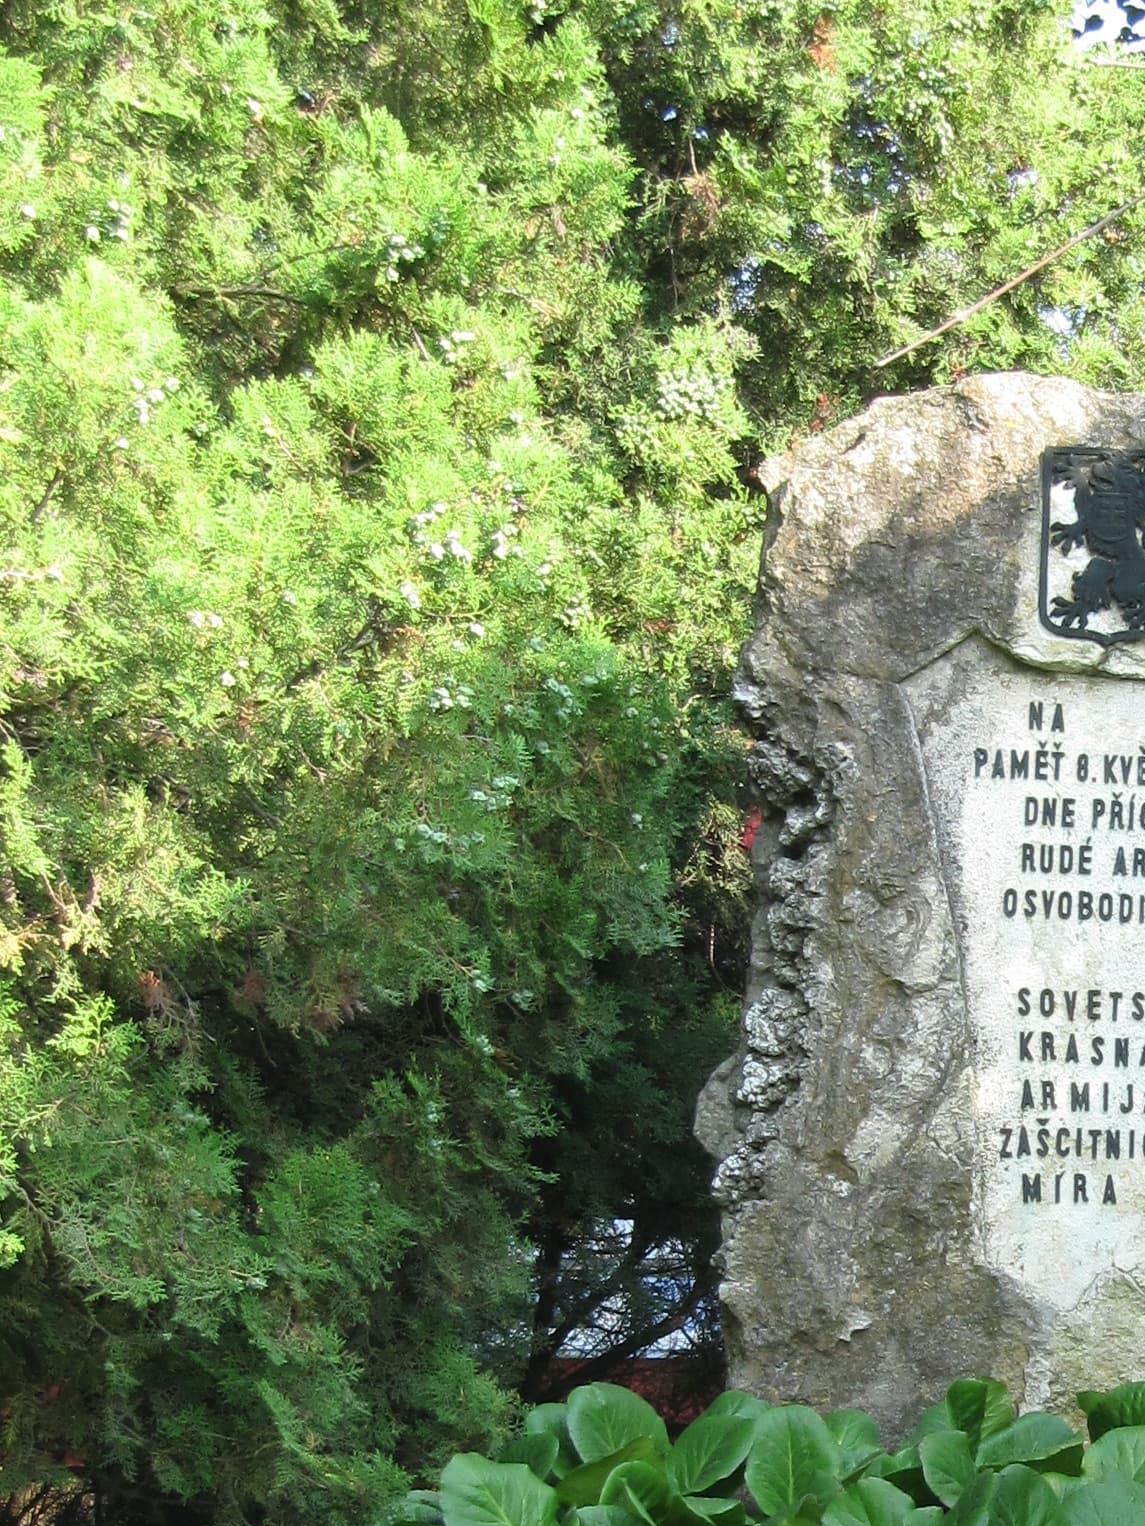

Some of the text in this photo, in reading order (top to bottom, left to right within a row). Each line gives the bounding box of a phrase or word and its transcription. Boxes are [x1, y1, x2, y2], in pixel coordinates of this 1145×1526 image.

[1028, 701, 1065, 733] NA
[974, 740, 1066, 781] PAMĚŤ
[1024, 796, 1076, 828] DNE
[1021, 836, 1093, 876] RUDÉ
